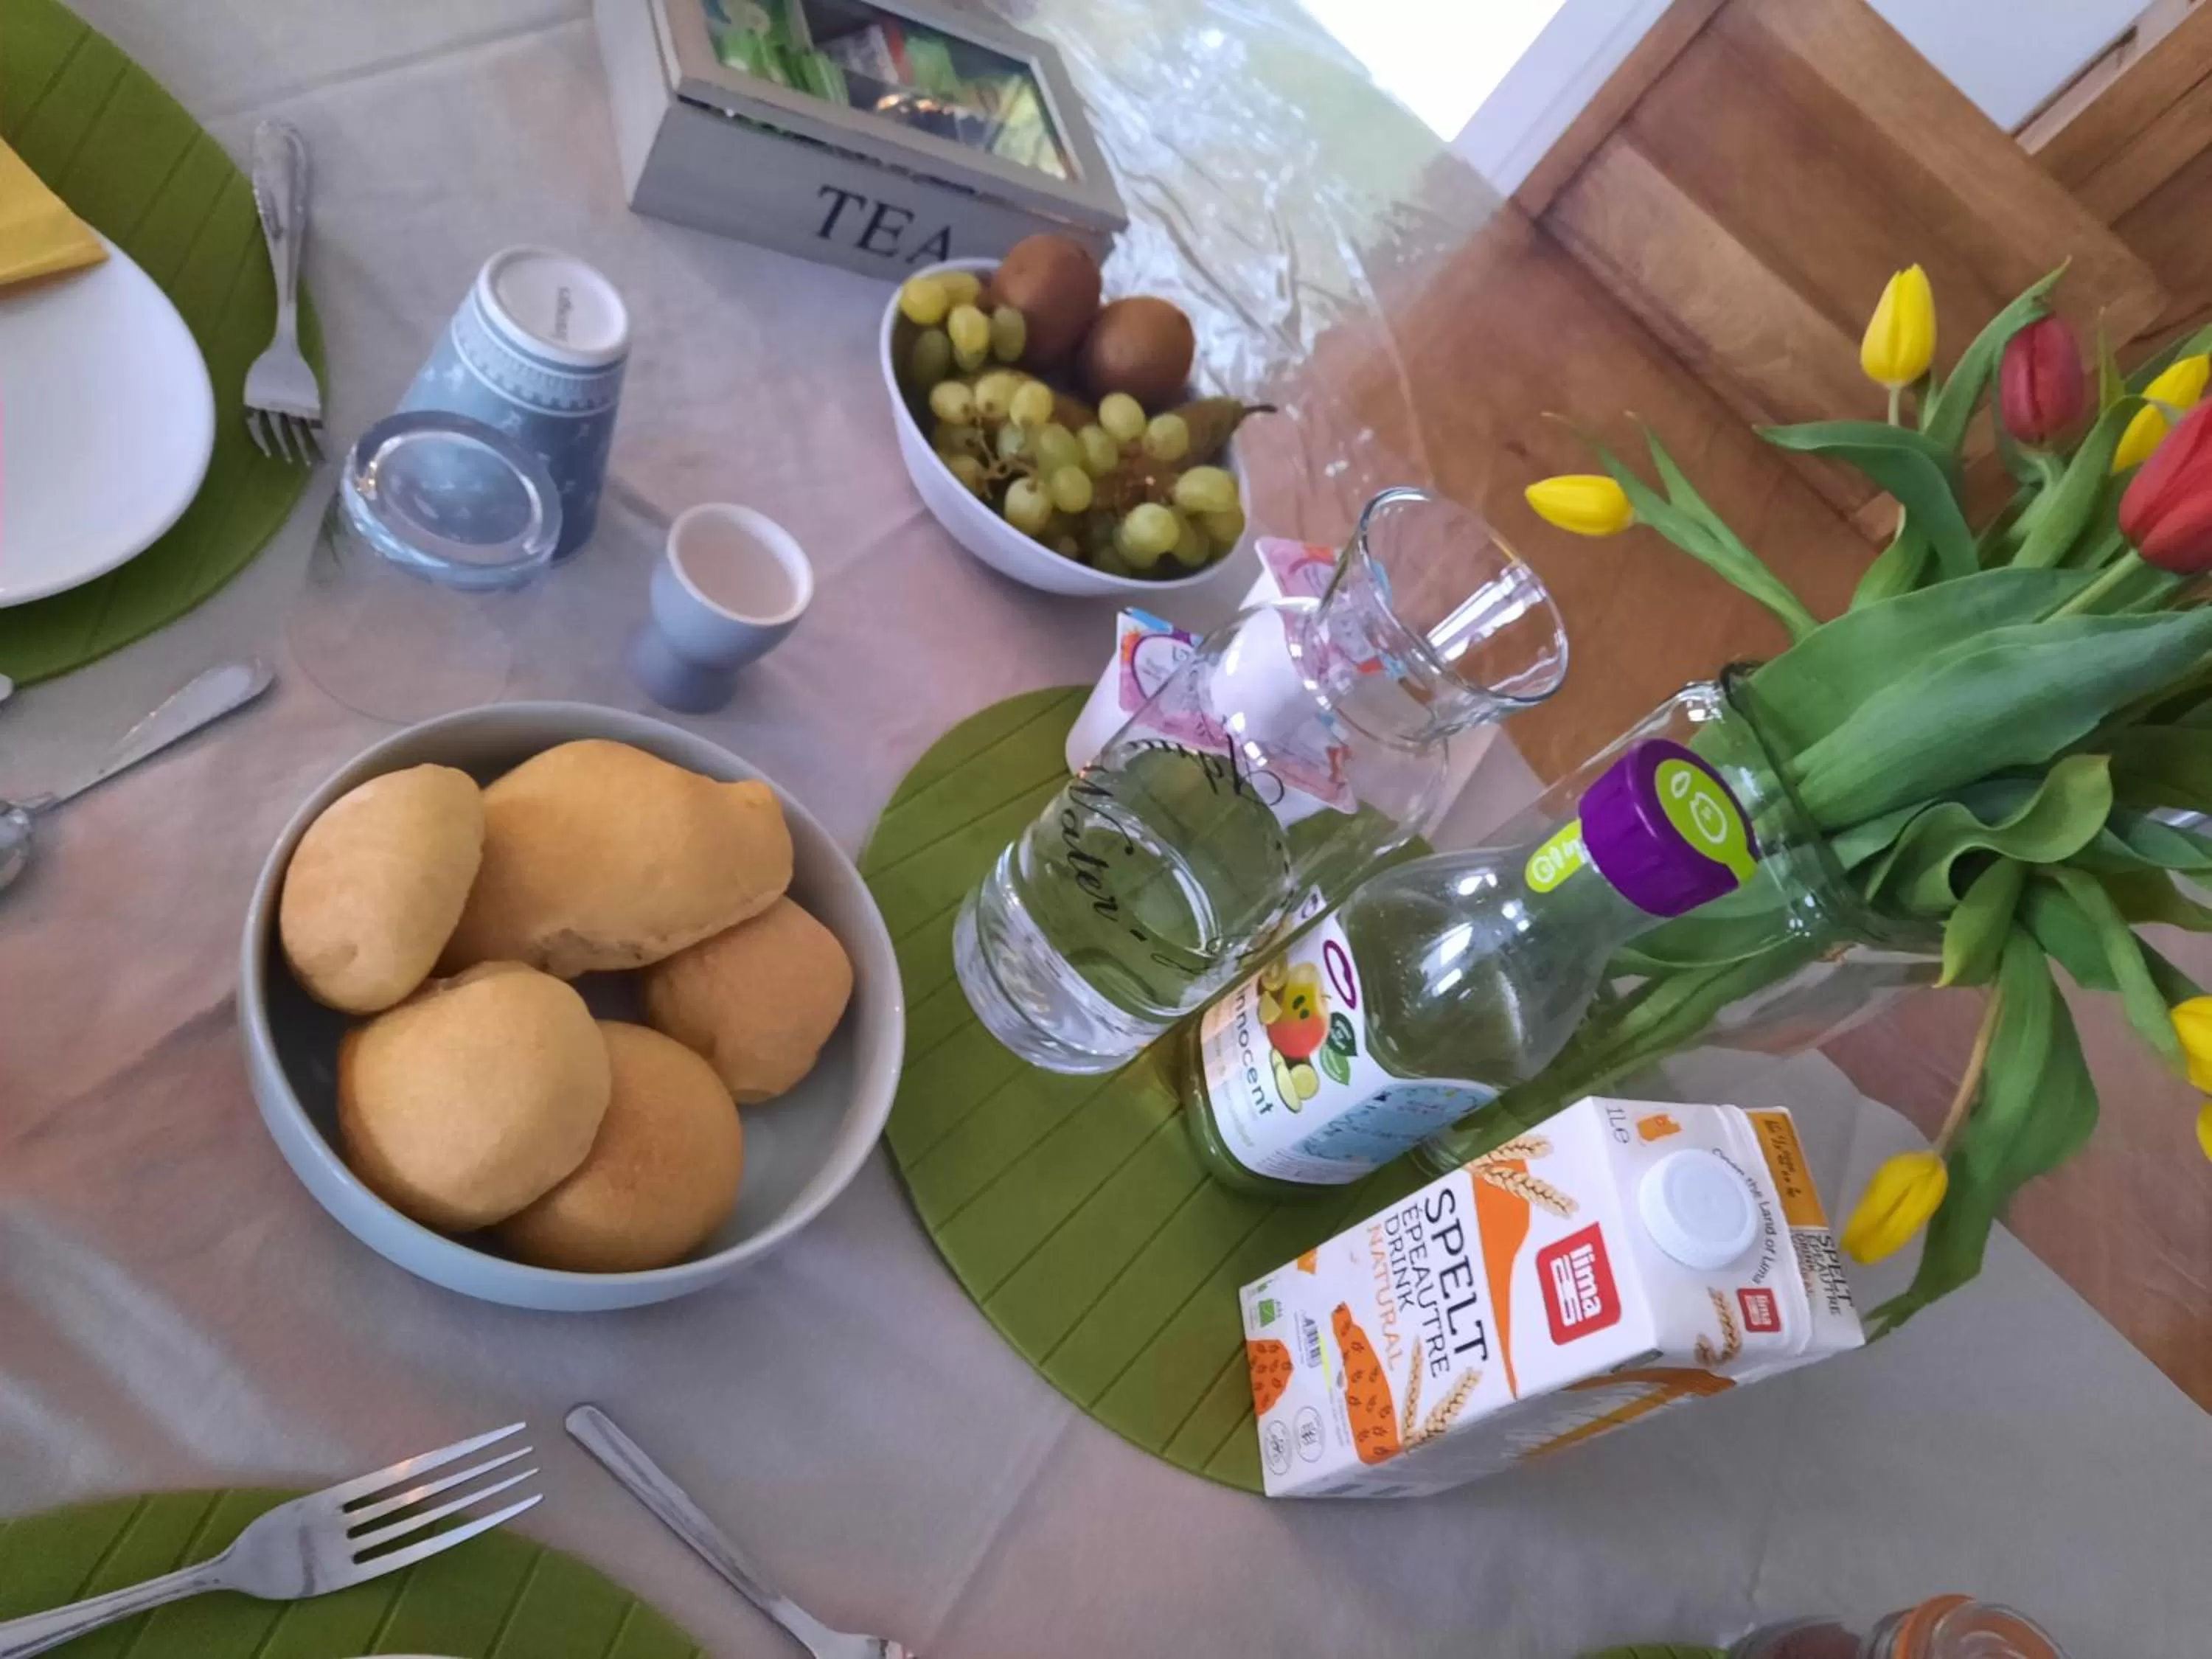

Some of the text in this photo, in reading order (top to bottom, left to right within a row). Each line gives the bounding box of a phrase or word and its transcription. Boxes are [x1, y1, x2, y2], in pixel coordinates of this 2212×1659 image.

[816, 184, 953, 264] TEA
[1384, 1213, 1415, 1313] DRINK
[1759, 1200, 1778, 1236] Land
[1366, 1222, 1403, 1371] NATURAL
[1401, 1203, 1451, 1378] ÉPEAUTRE
[1424, 1188, 1489, 1362] SPELT
[1572, 1242, 1602, 1318] lima
